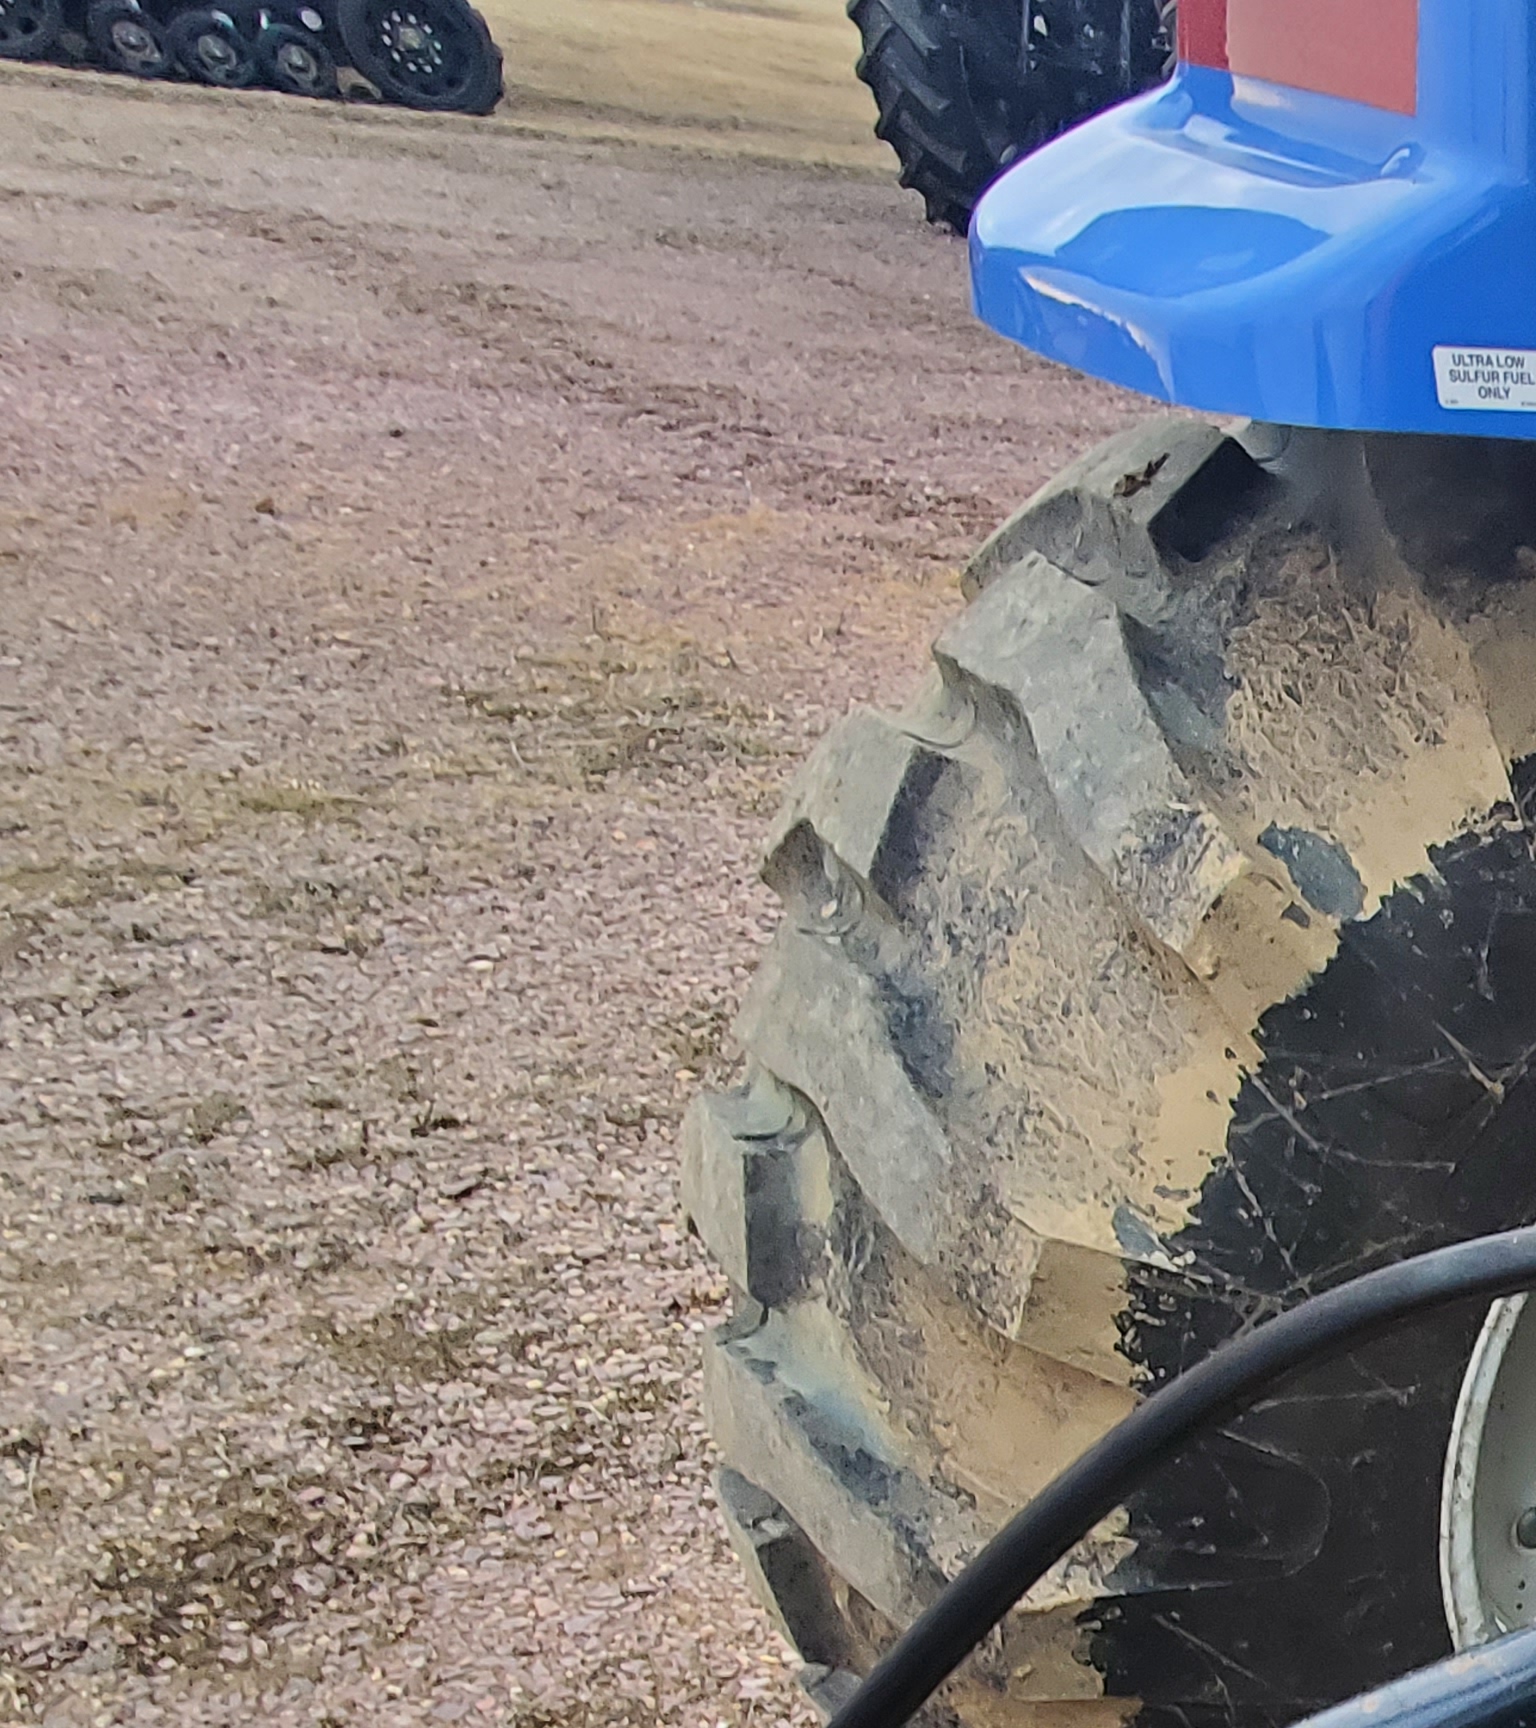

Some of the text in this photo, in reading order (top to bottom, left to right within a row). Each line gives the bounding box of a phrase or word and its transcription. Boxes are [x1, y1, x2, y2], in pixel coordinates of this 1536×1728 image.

[1452, 354, 1525, 369] ULTRA LOW
[1449, 369, 1535, 385] SULFUR FUEL
[1478, 386, 1511, 399] ONLY
